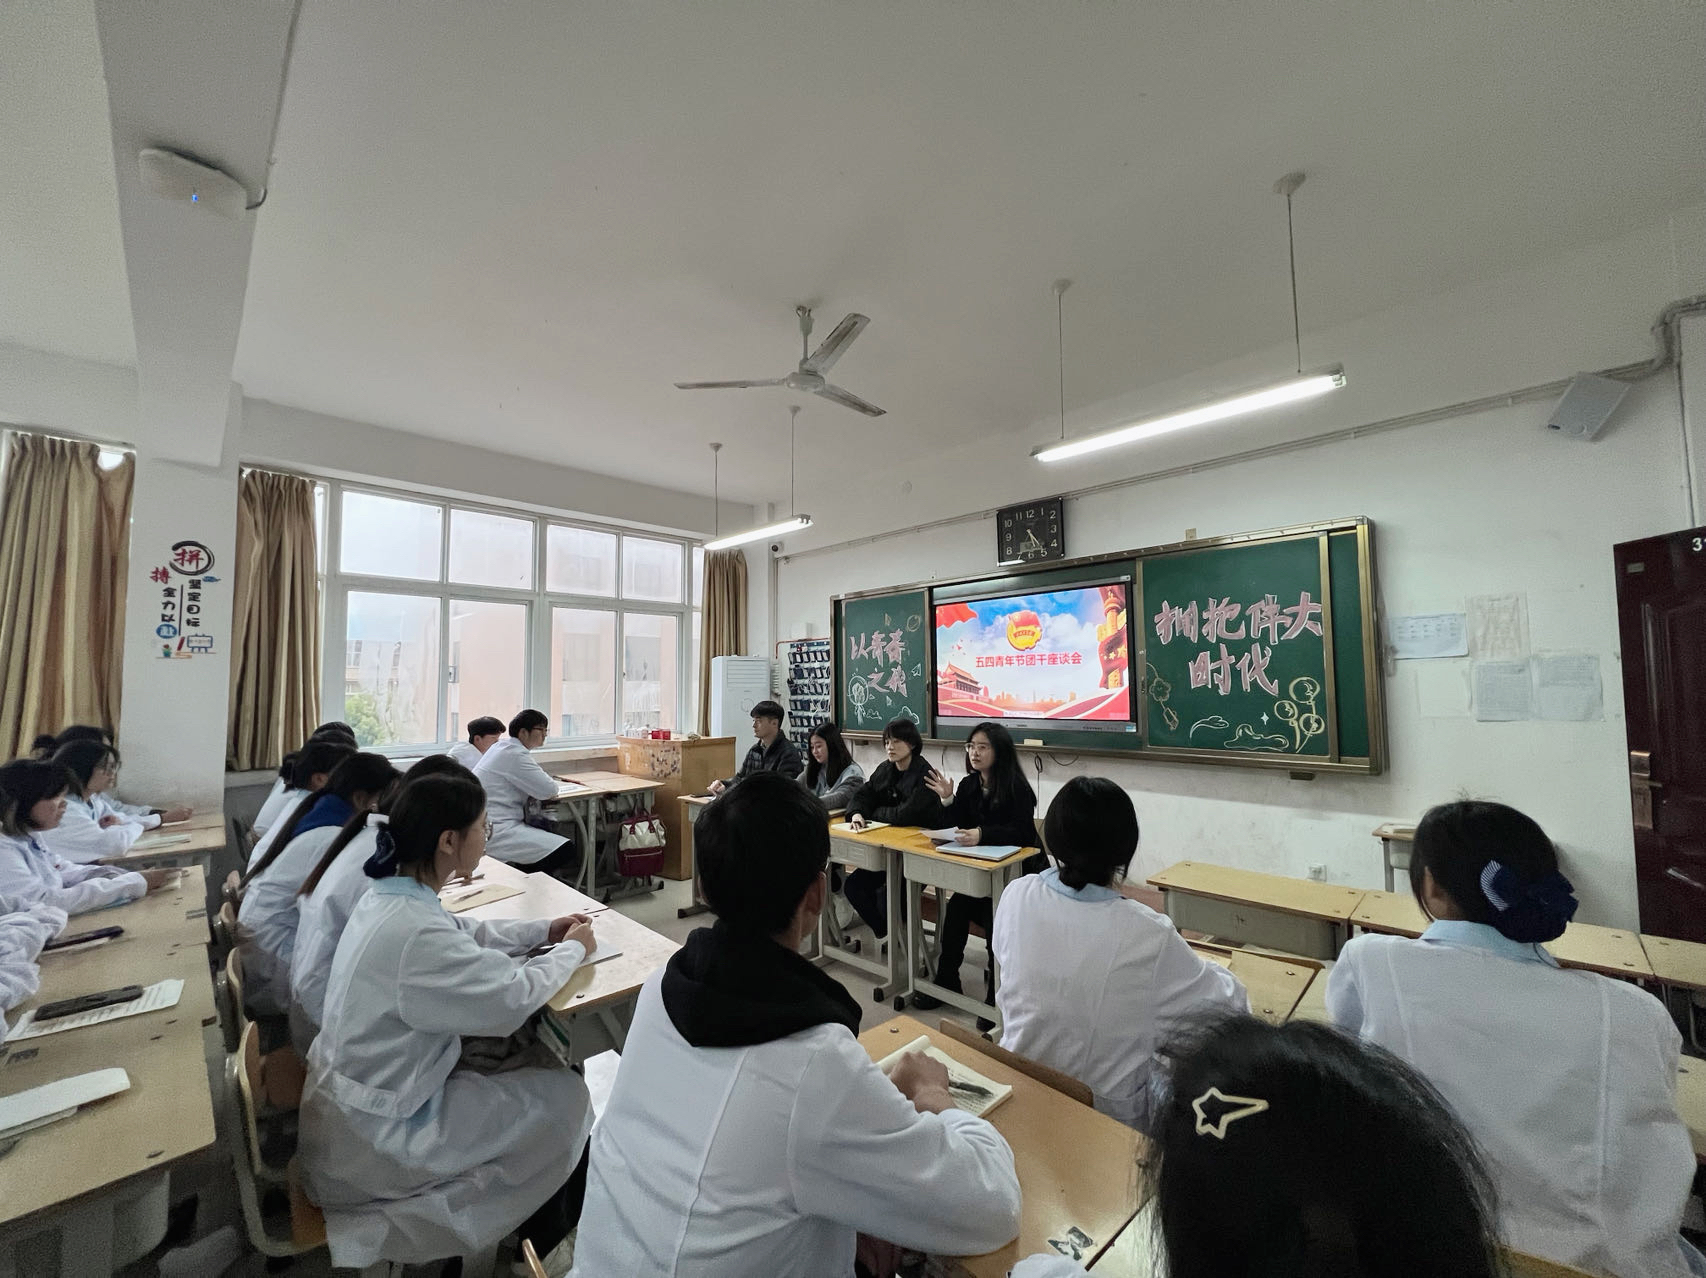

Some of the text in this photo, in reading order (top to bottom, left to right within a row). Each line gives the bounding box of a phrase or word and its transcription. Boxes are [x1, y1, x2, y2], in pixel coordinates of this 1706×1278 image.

[1015, 511, 1023, 520] 11
[1026, 509, 1035, 518] 12
[1050, 510, 1056, 519] 2
[1004, 519, 1013, 528] 10
[1050, 524, 1057, 534] 3
[1005, 532, 1012, 541] 9
[1050, 539, 1058, 547] 4
[1692, 537, 1706, 552] 3
[1006, 546, 1013, 555] 8
[1017, 551, 1023, 560] 7
[1028, 550, 1035, 559] 6
[1040, 546, 1048, 557] 5
[173, 548, 204, 571] 拼
[150, 566, 172, 584] 搏
[185, 579, 201, 627] 坚定目标
[1154, 591, 1323, 645] 拥抱伟大
[849, 628, 906, 667] 以青春
[975, 651, 1082, 668] 五四青年节团干座谈会
[1189, 642, 1278, 697] 时代
[867, 665, 907, 698] 之我
